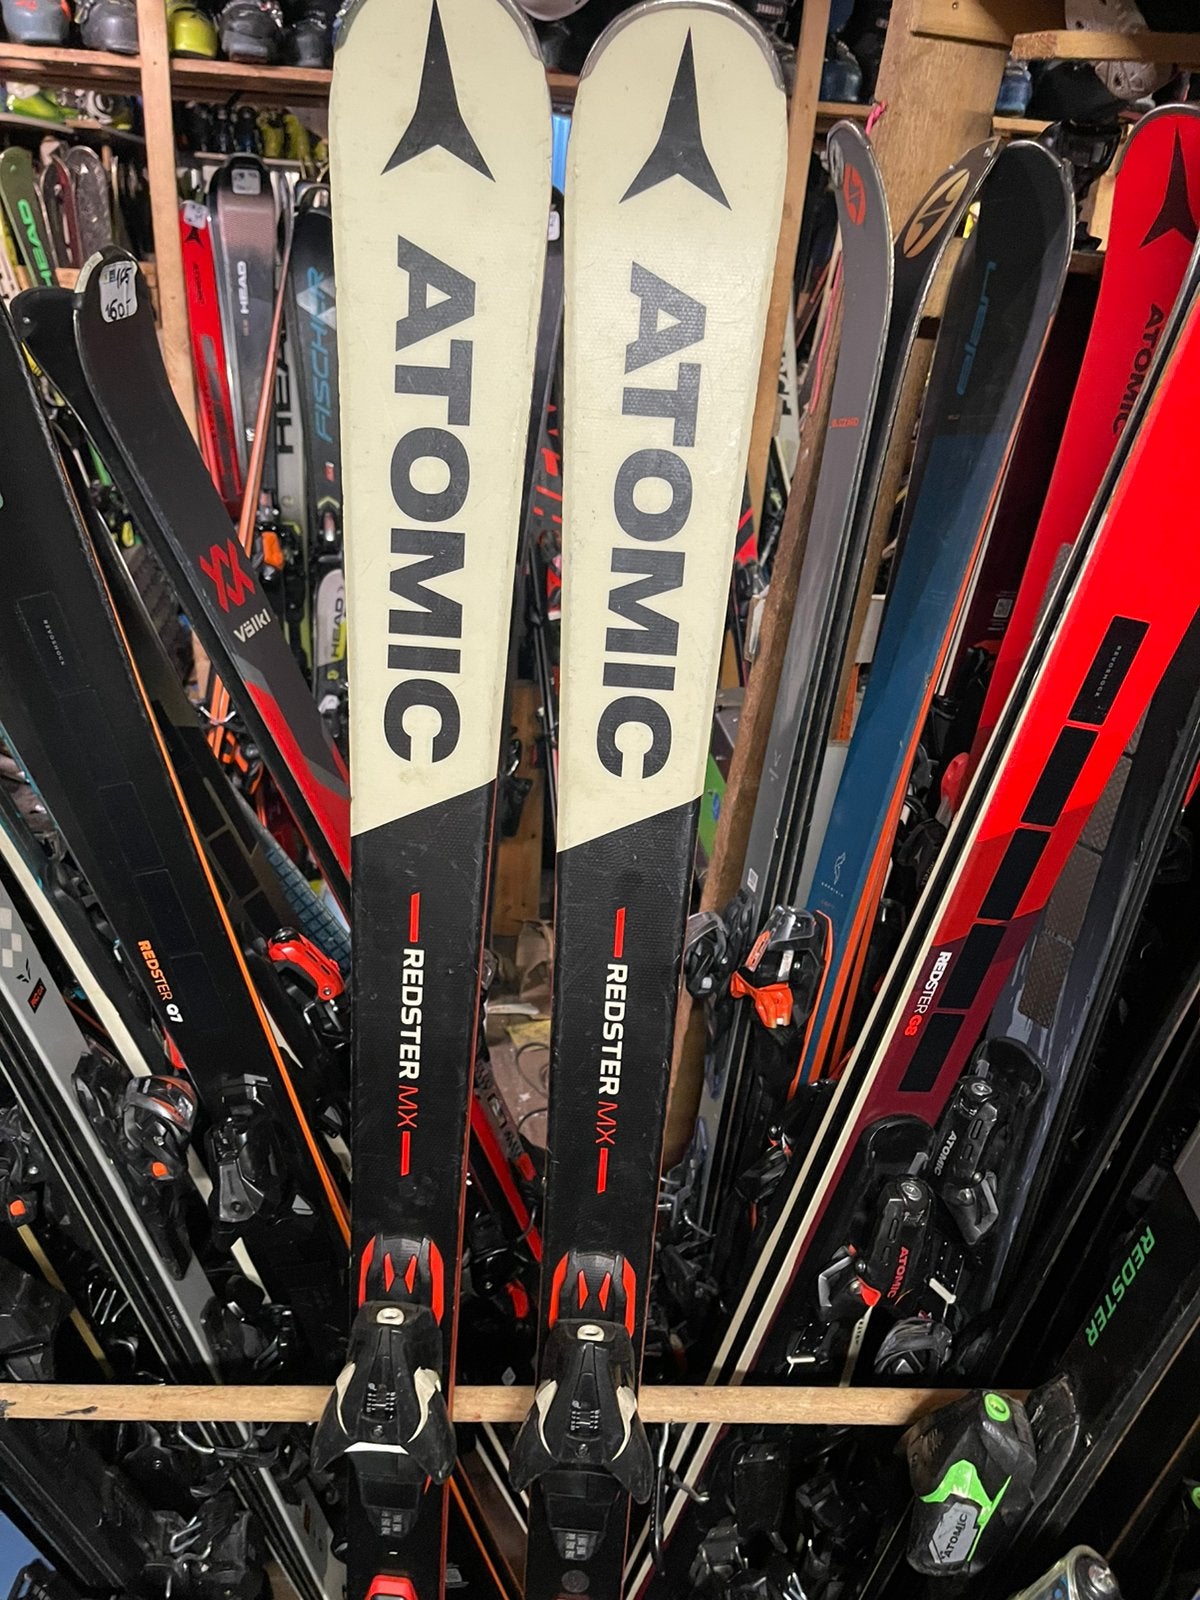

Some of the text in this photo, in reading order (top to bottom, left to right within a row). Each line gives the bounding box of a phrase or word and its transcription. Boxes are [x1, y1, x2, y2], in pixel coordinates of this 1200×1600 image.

[237, 260, 250, 314] HEAD
[383, 234, 476, 763] ATOMIC
[596, 261, 707, 780] ATOMIC
[233, 608, 271, 642] Völkl
[137, 940, 173, 1000] REDSTER
[914, 951, 952, 1014] REDSTER
[397, 948, 425, 1128] REDSTER MX
[595, 963, 628, 1145] REDSTER MX
[934, 1130, 957, 1176] ATOMIC
[887, 1246, 909, 1298] ATOMIC
[1085, 1225, 1155, 1347] REDSTER
[944, 1513, 968, 1558] ATOMIC
